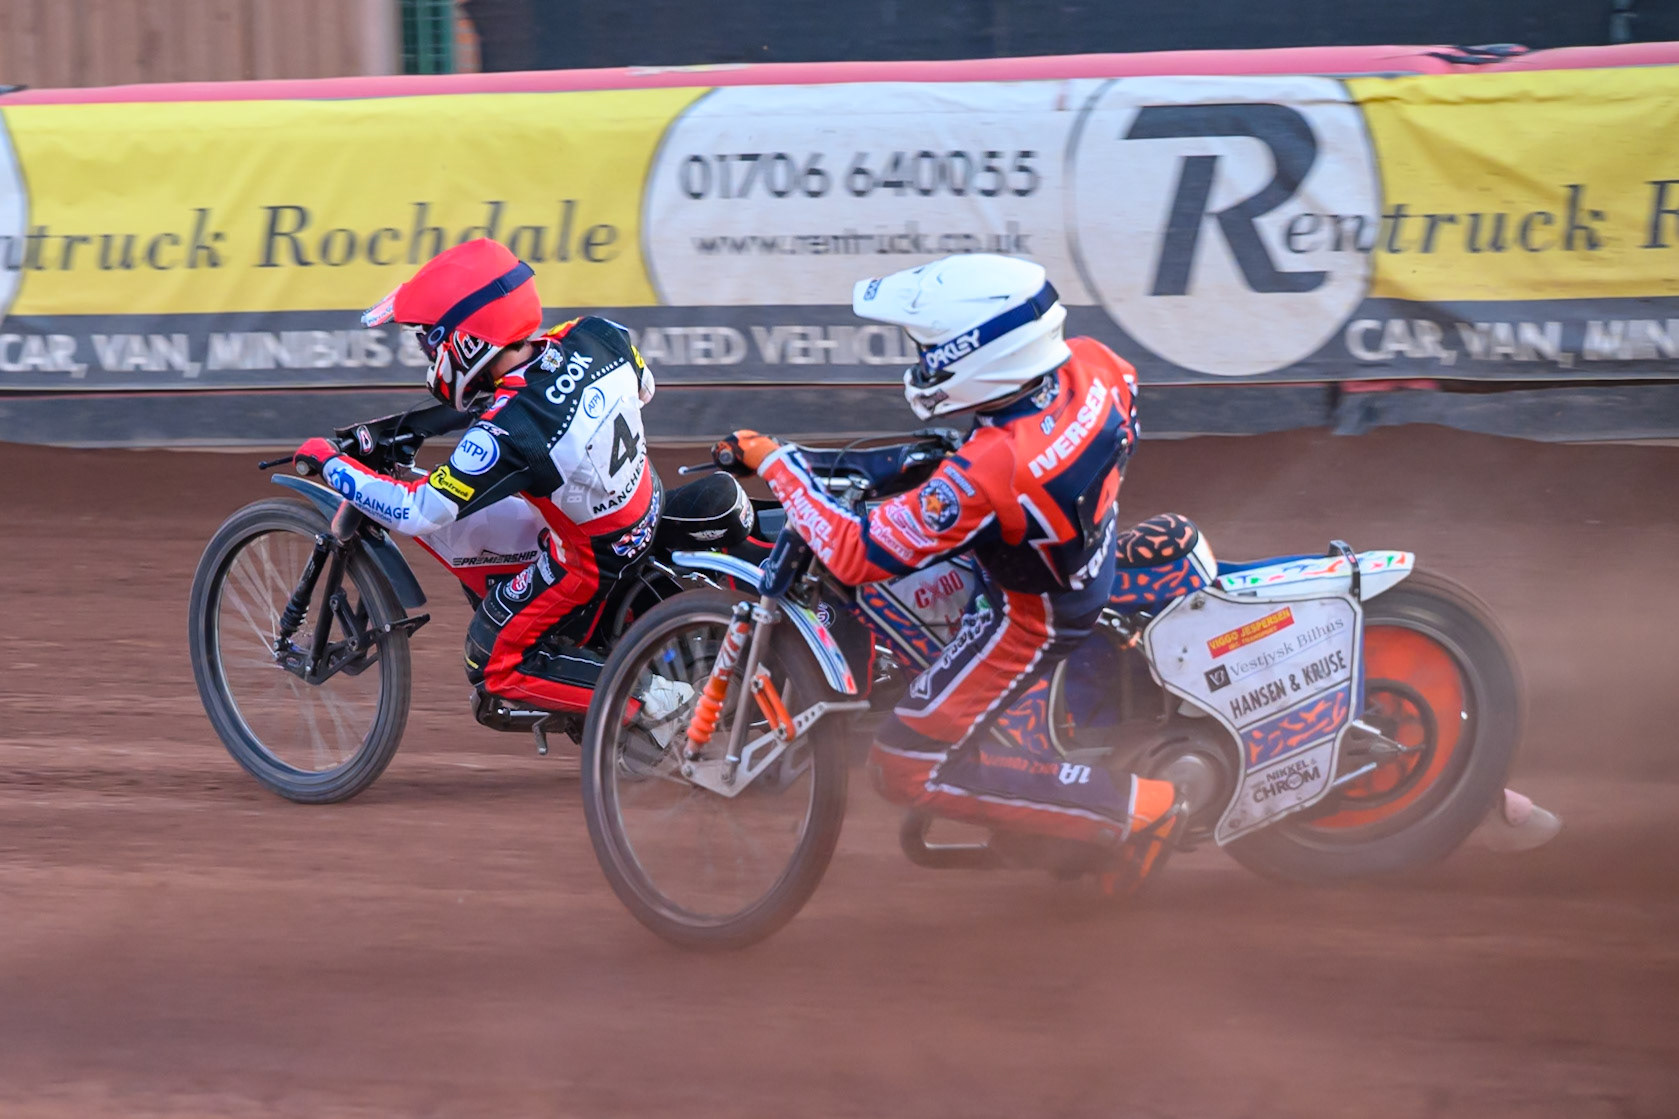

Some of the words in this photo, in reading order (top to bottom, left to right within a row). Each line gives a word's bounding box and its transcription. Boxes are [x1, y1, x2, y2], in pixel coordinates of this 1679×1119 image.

[681, 152, 831, 200] 01706
[846, 150, 1042, 199] 640055
[0, 207, 226, 271] truck
[0, 333, 88, 378] CAR,
[91, 333, 200, 378] VAN,
[925, 328, 980, 369] OAKLEY
[1345, 319, 1457, 366] CAR,
[1455, 321, 1574, 368] VAN,
[545, 351, 593, 405] COOK
[457, 439, 489, 463] ATPI
[608, 412, 641, 479] 4
[1028, 377, 1108, 479] IVERSEN
[1296, 618, 1345, 649] Bilhus
[1229, 678, 1288, 720] HANSEN
[1288, 673, 1302, 692] &
[1301, 650, 1347, 686] KRUSE
[1252, 765, 1321, 804] CHROM
[1266, 759, 1309, 782] NIKKEL
